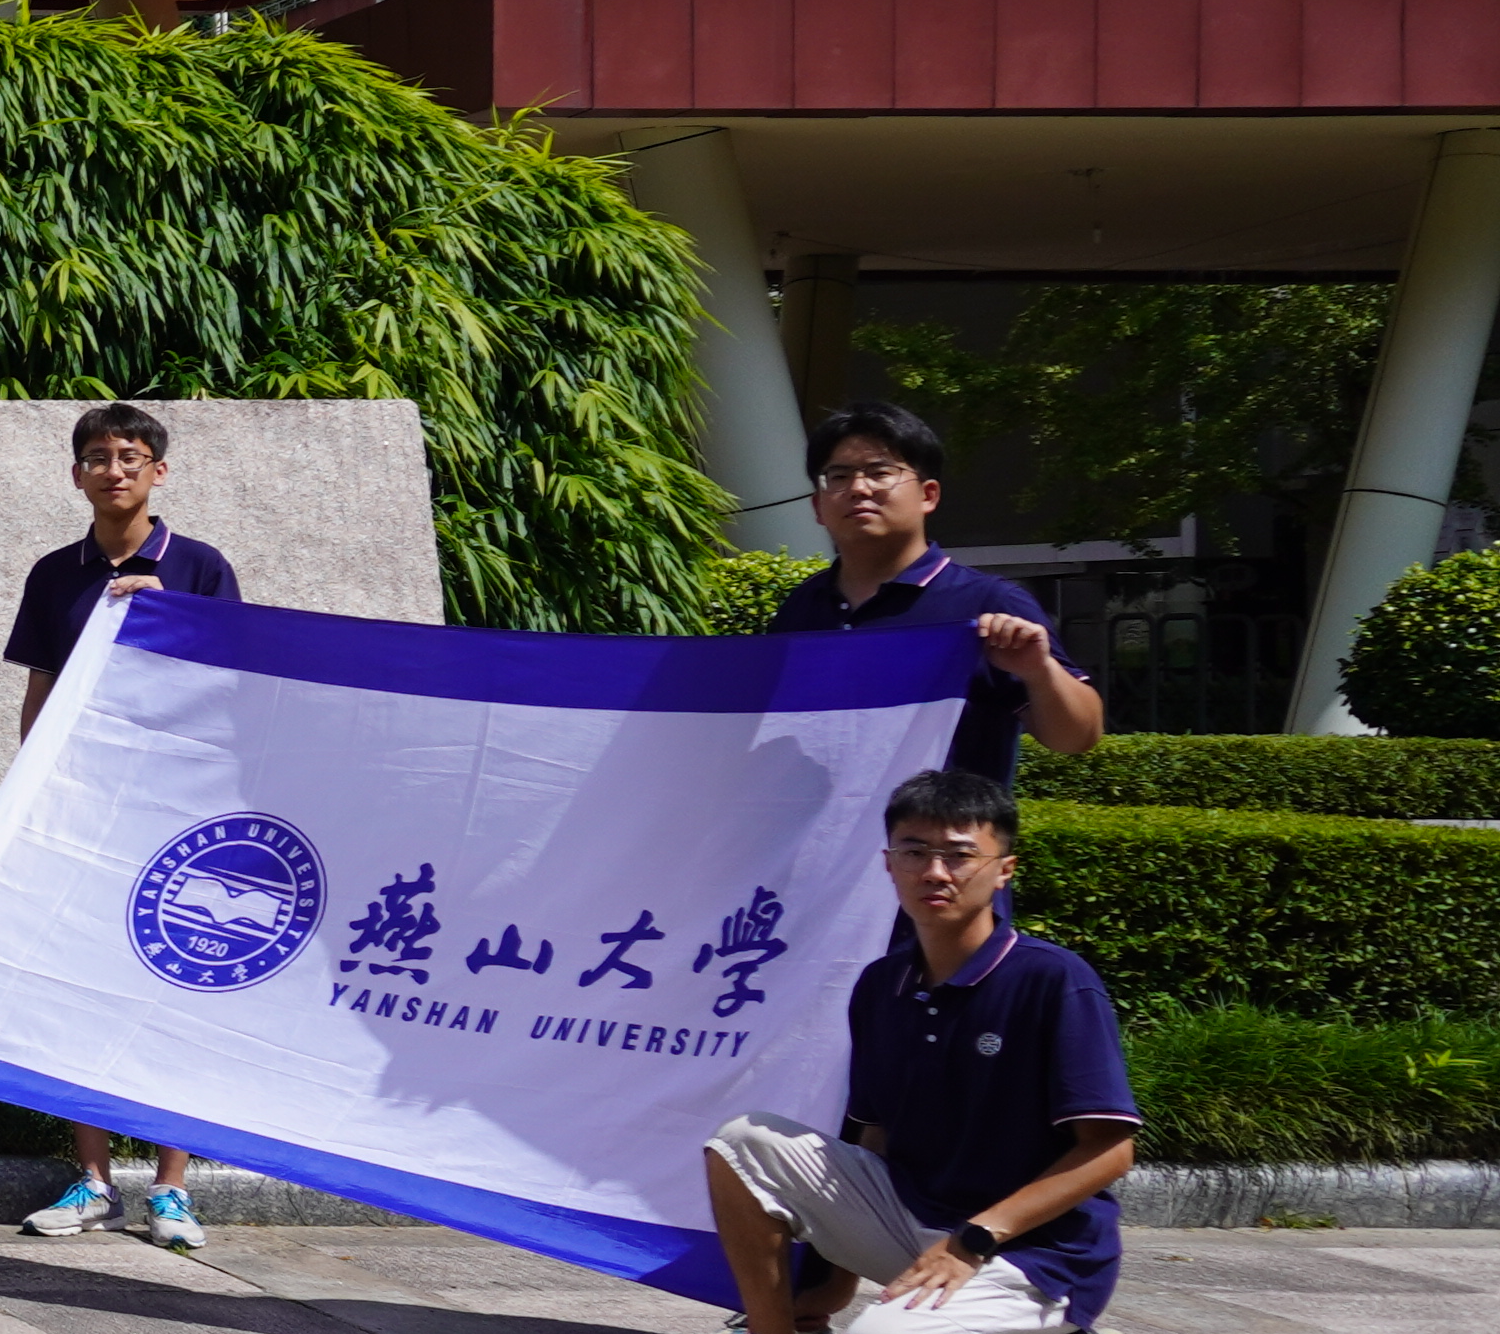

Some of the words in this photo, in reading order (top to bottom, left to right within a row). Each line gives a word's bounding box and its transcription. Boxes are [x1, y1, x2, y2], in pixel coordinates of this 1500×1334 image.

[138, 825, 227, 917] YANSHAN
[248, 823, 315, 956] UNIVERSITY
[187, 935, 230, 958] 1920
[328, 982, 499, 1035] YANSHAN
[530, 1015, 750, 1058] UNIVERSITY
